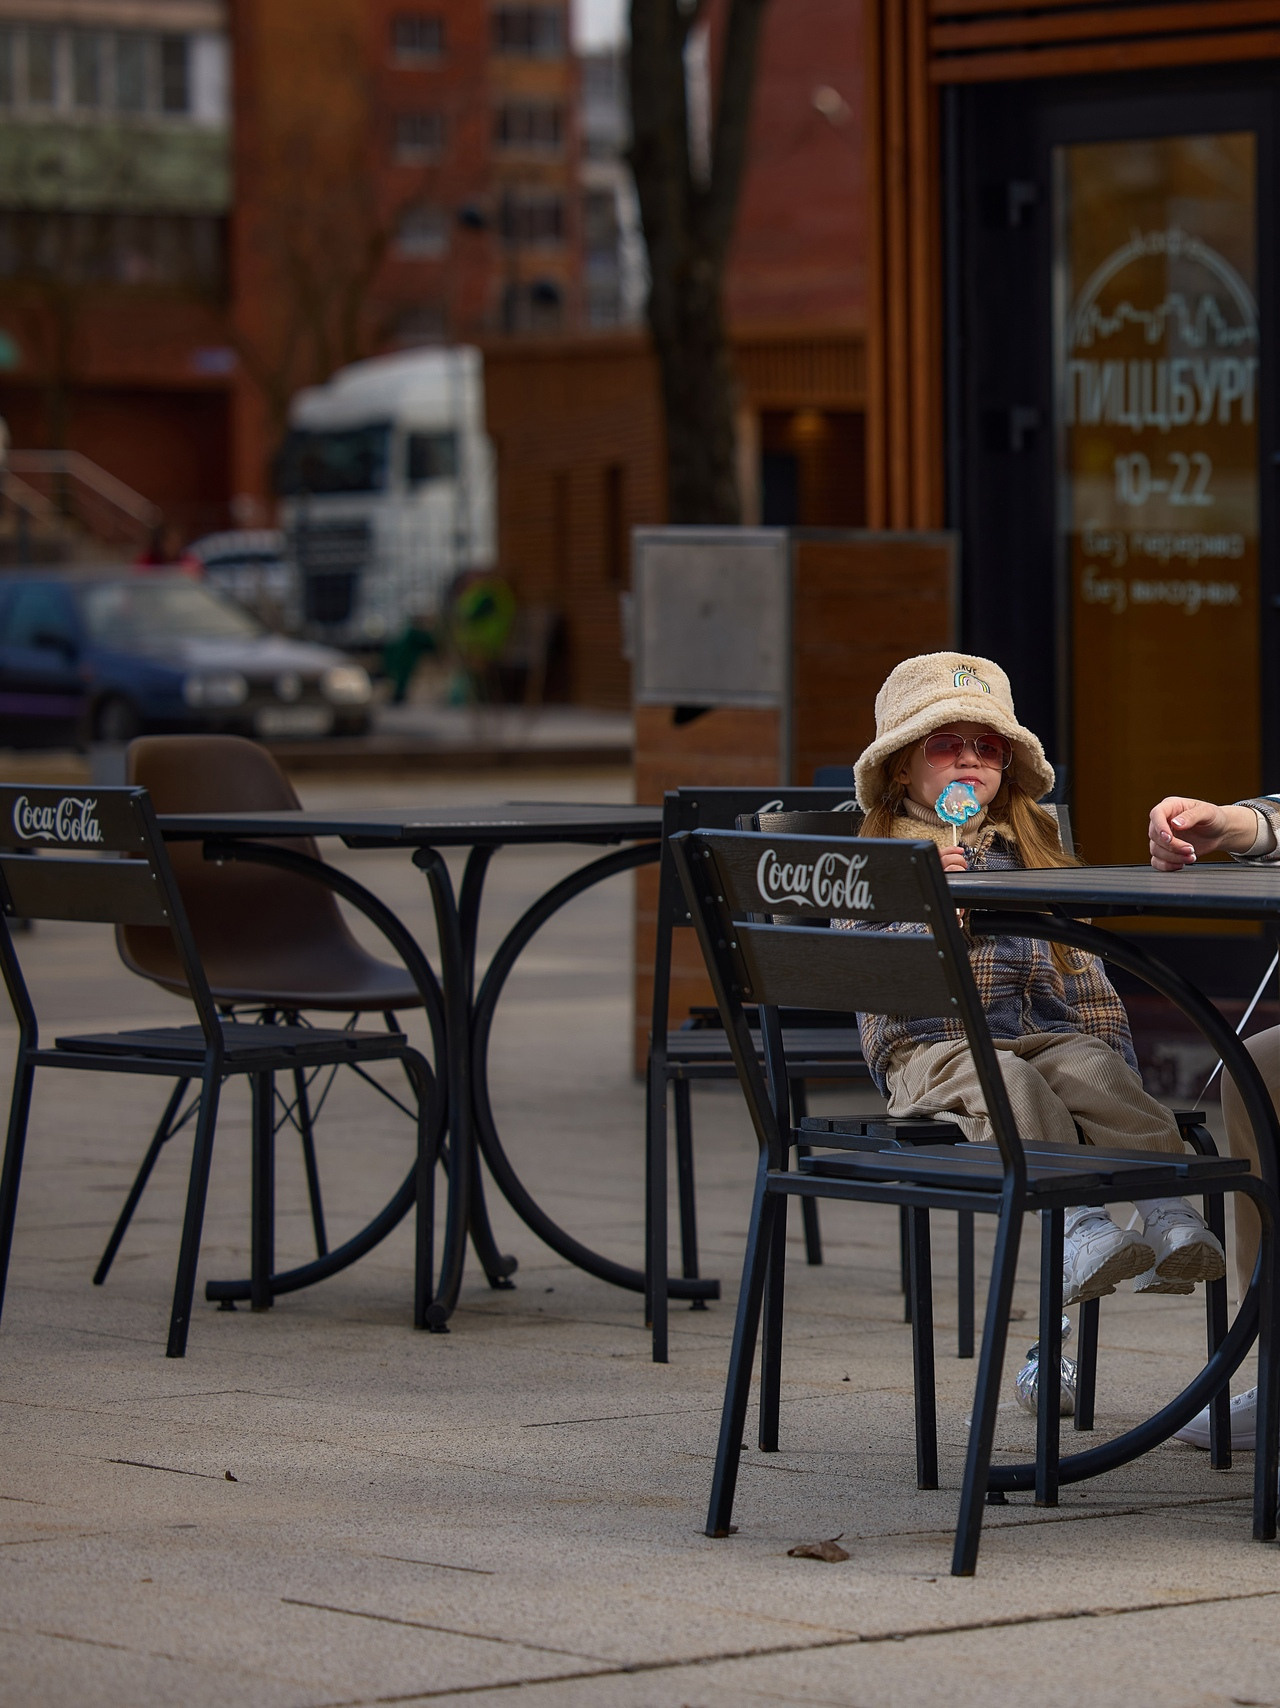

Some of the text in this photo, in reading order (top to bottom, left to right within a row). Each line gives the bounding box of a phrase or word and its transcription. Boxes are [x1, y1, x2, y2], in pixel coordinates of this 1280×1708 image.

[1066, 357, 1258, 434] ПИЦЦБУРГ
[1081, 564, 1128, 614] без
[13, 795, 105, 843] Coca-Cola
[756, 848, 875, 910] Coca-Cola
